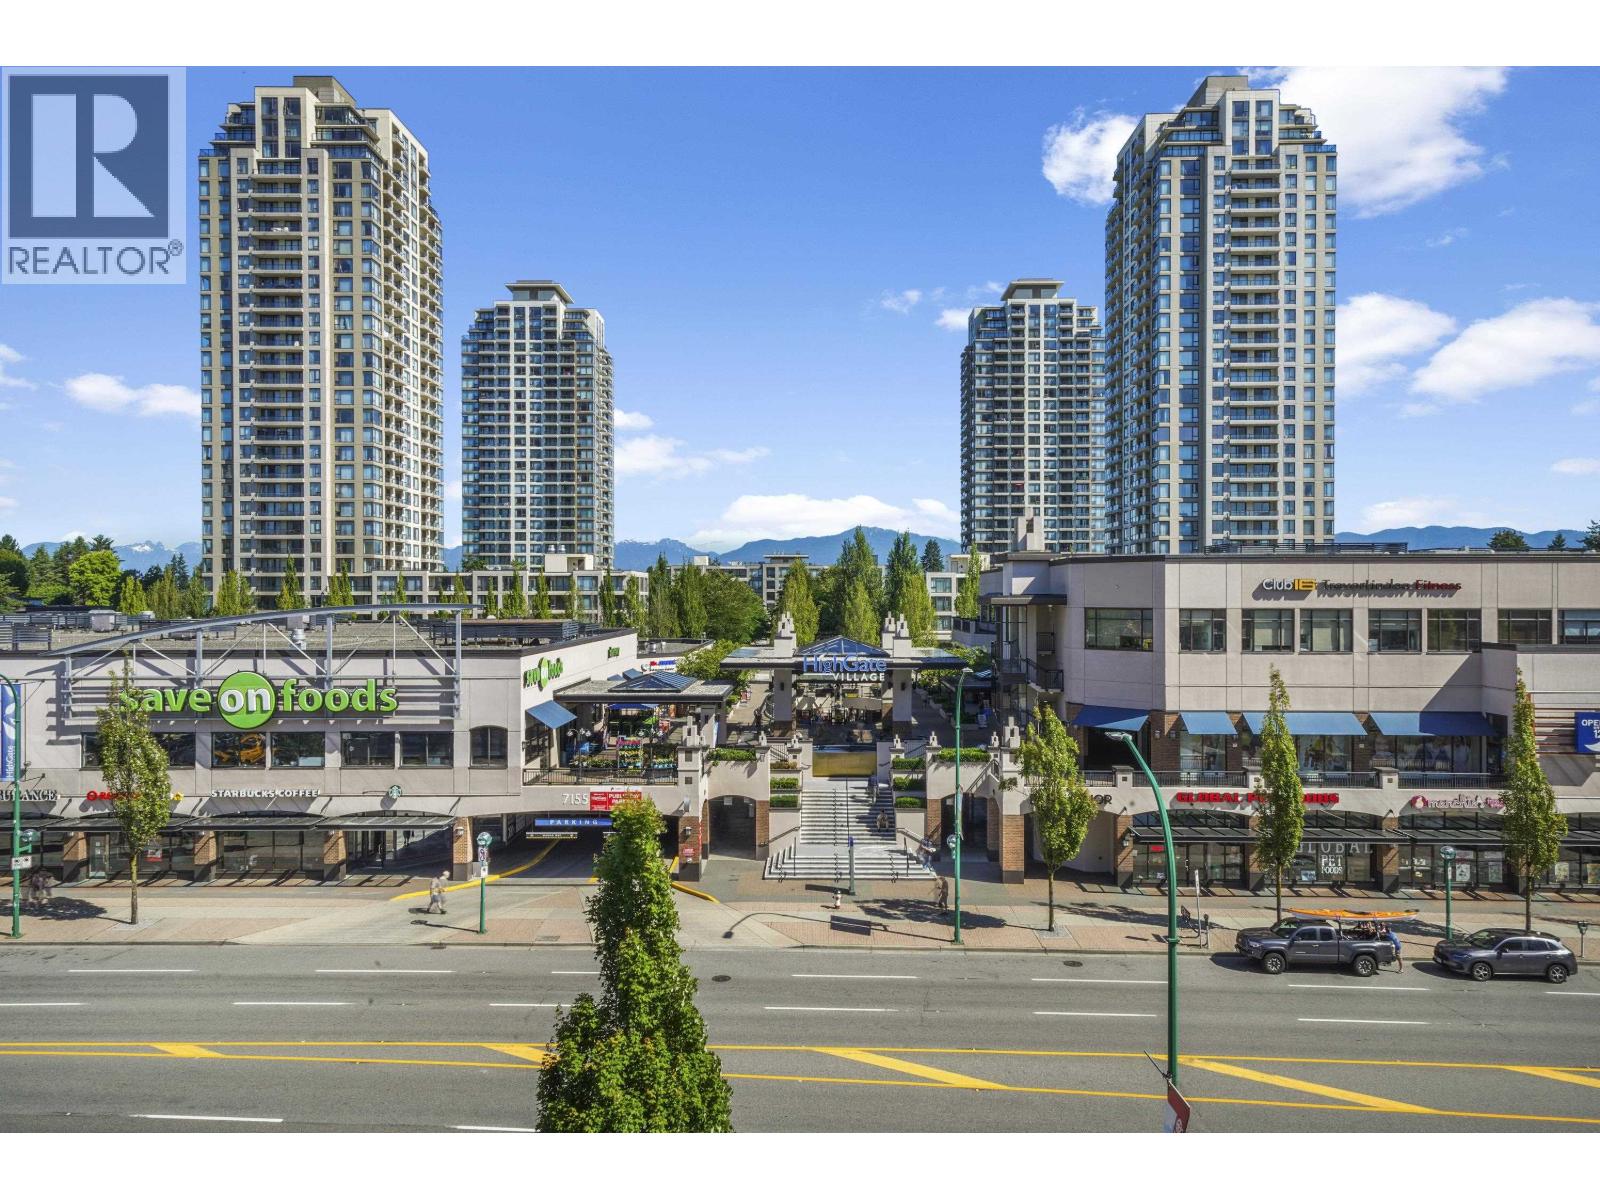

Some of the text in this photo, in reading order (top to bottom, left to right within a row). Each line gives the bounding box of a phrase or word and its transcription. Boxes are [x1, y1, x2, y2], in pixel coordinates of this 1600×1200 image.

[1262, 578, 1293, 591] Club
[1293, 578, 1317, 592] 16
[1415, 579, 1462, 591] Fitness
[803, 654, 888, 675] HighGate
[832, 672, 886, 682] VILLAGE
[219, 688, 272, 714] on
[280, 679, 399, 712] foods
[1581, 719, 1600, 727] OPE
[210, 788, 320, 798] STARBUCKS COFFEE
[561, 792, 588, 806] 7155
[1321, 854, 1344, 867] PET
